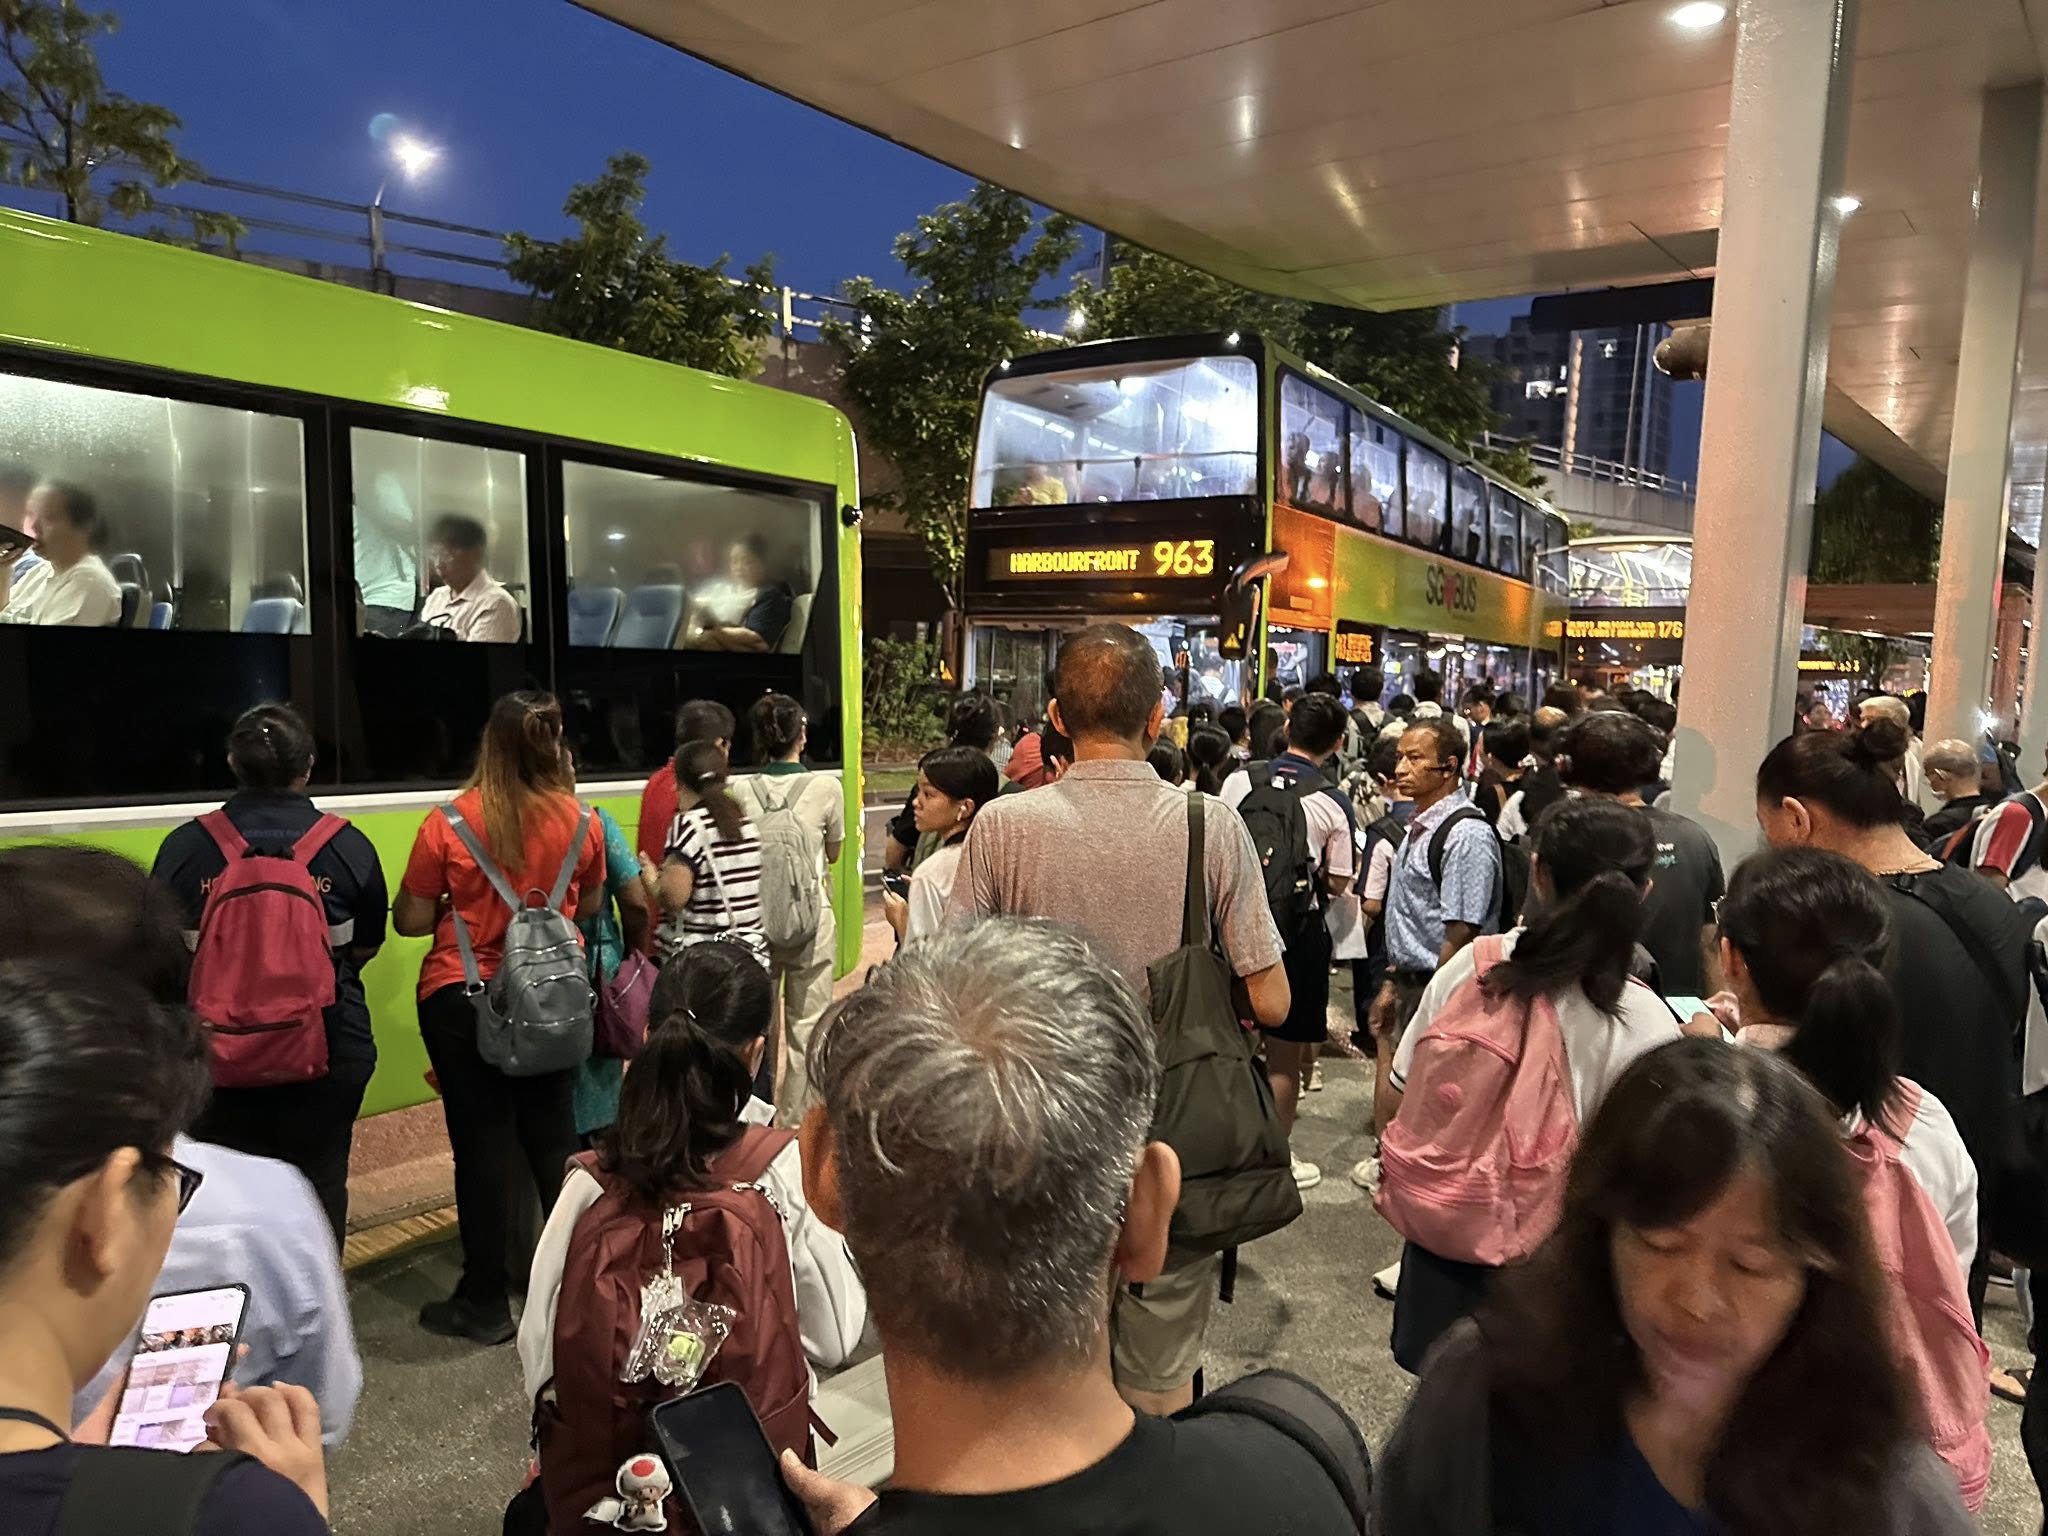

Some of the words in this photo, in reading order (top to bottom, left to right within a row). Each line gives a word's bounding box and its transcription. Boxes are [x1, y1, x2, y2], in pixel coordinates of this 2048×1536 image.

[1010, 550, 1140, 573] HARBOURFRONT
[1153, 540, 1214, 575] 963
[1658, 620, 1683, 639] 176
